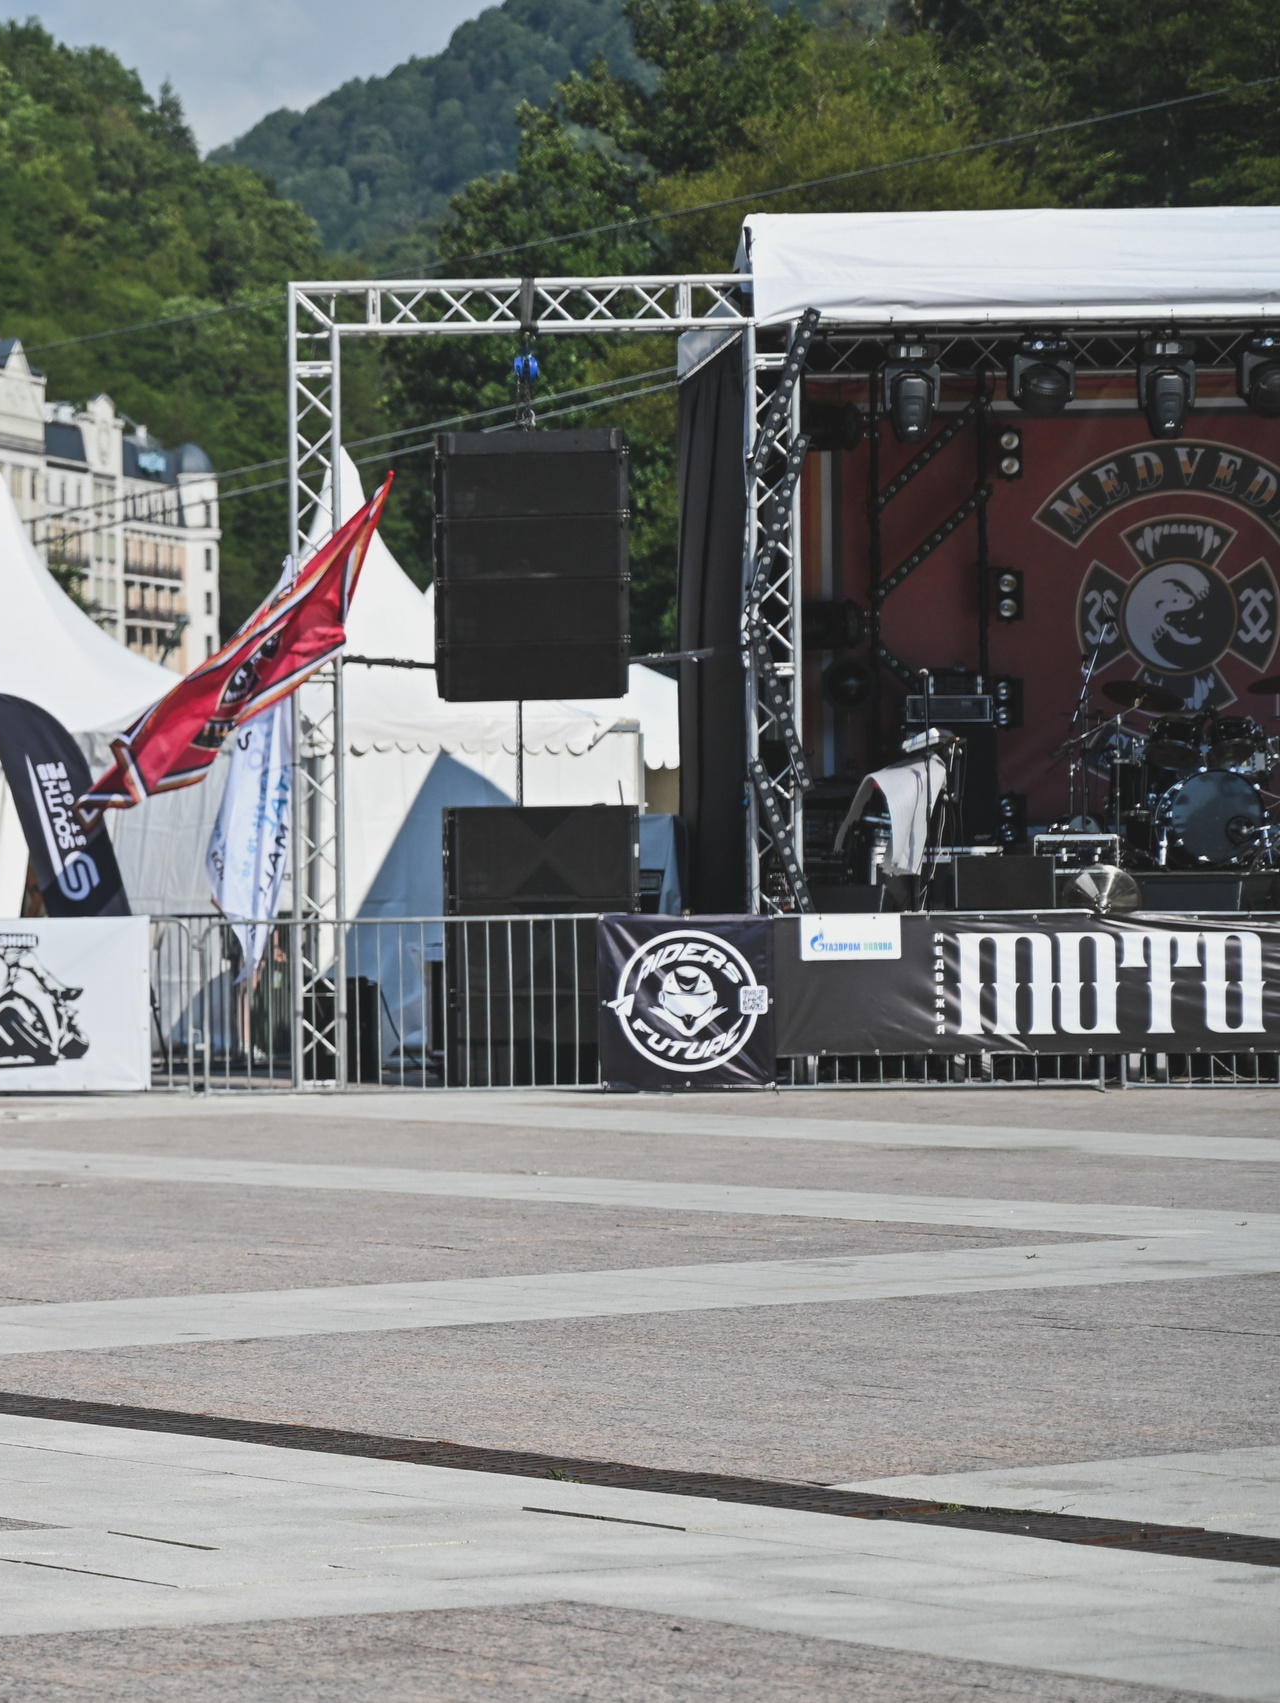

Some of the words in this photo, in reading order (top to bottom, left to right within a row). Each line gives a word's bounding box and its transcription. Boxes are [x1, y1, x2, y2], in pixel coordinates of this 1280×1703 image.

[43, 781, 75, 849] SOUTH
[635, 942, 744, 992] RIDERS
[825, 942, 861, 952] ГАЗПРОМ
[863, 941, 893, 951] ПОЛЯНА
[934, 932, 946, 1035] МЕДВЕЖЬЯ
[632, 1015, 745, 1060] FUTURE
